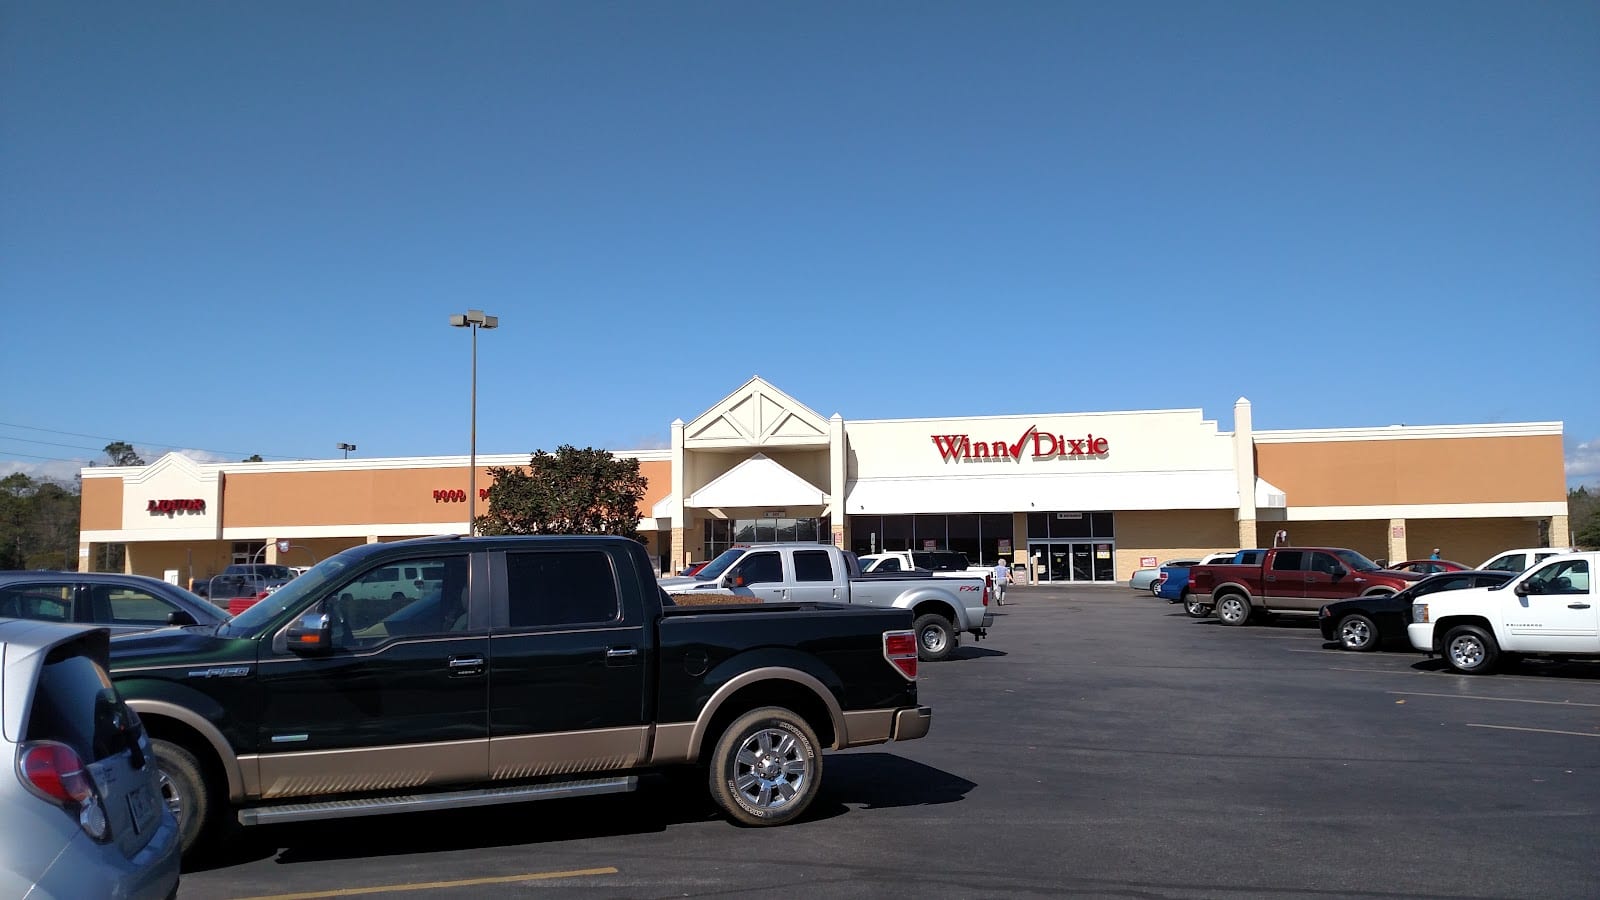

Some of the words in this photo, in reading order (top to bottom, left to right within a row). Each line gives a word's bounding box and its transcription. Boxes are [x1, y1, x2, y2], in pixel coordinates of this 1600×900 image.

[931, 434, 1010, 460] Winn
[1031, 431, 1109, 458] Dixie
[433, 489, 466, 501] FOOD
[146, 499, 206, 514] LIQUOR
